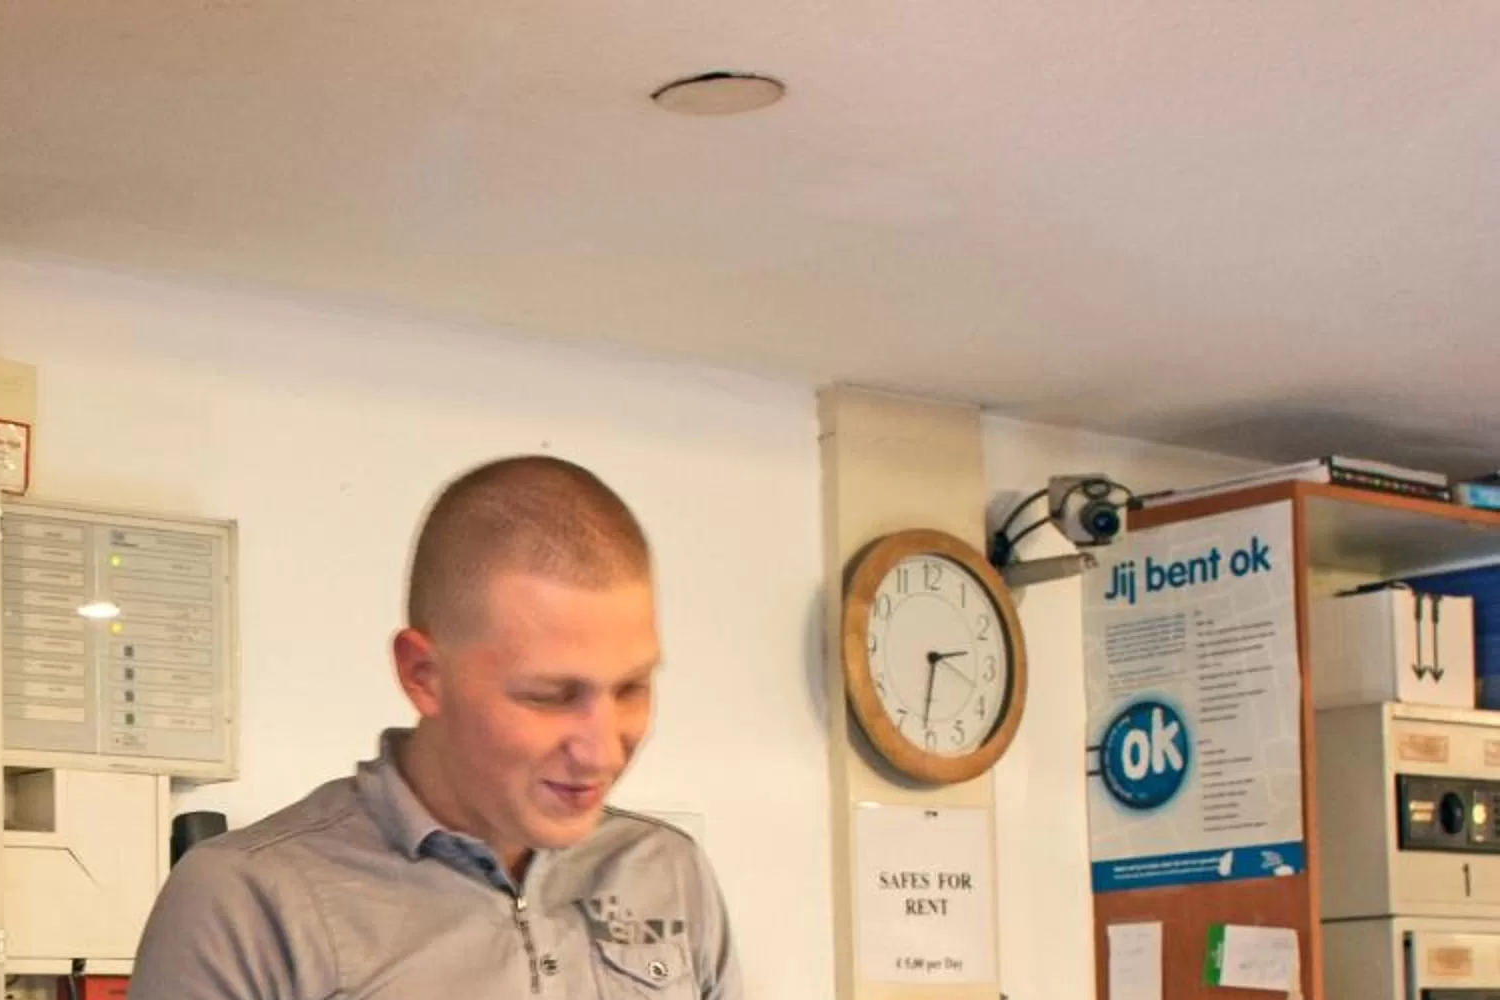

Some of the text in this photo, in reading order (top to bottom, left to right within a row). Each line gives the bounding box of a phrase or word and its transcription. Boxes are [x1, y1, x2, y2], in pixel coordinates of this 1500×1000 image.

[896, 568, 909, 595] 11
[923, 562, 942, 591] 12
[1104, 536, 1273, 605] Jij bent ok
[873, 593, 893, 621] 10
[960, 583, 966, 609] 1
[976, 614, 990, 642] 2
[982, 655, 997, 683] 3
[975, 695, 986, 721] 4
[951, 718, 966, 746] 5
[1122, 707, 1184, 781] ok
[879, 871, 972, 891] SAFES FOR
[1462, 863, 1470, 896] 1
[905, 898, 948, 916] RENT
[943, 957, 964, 973] Day
